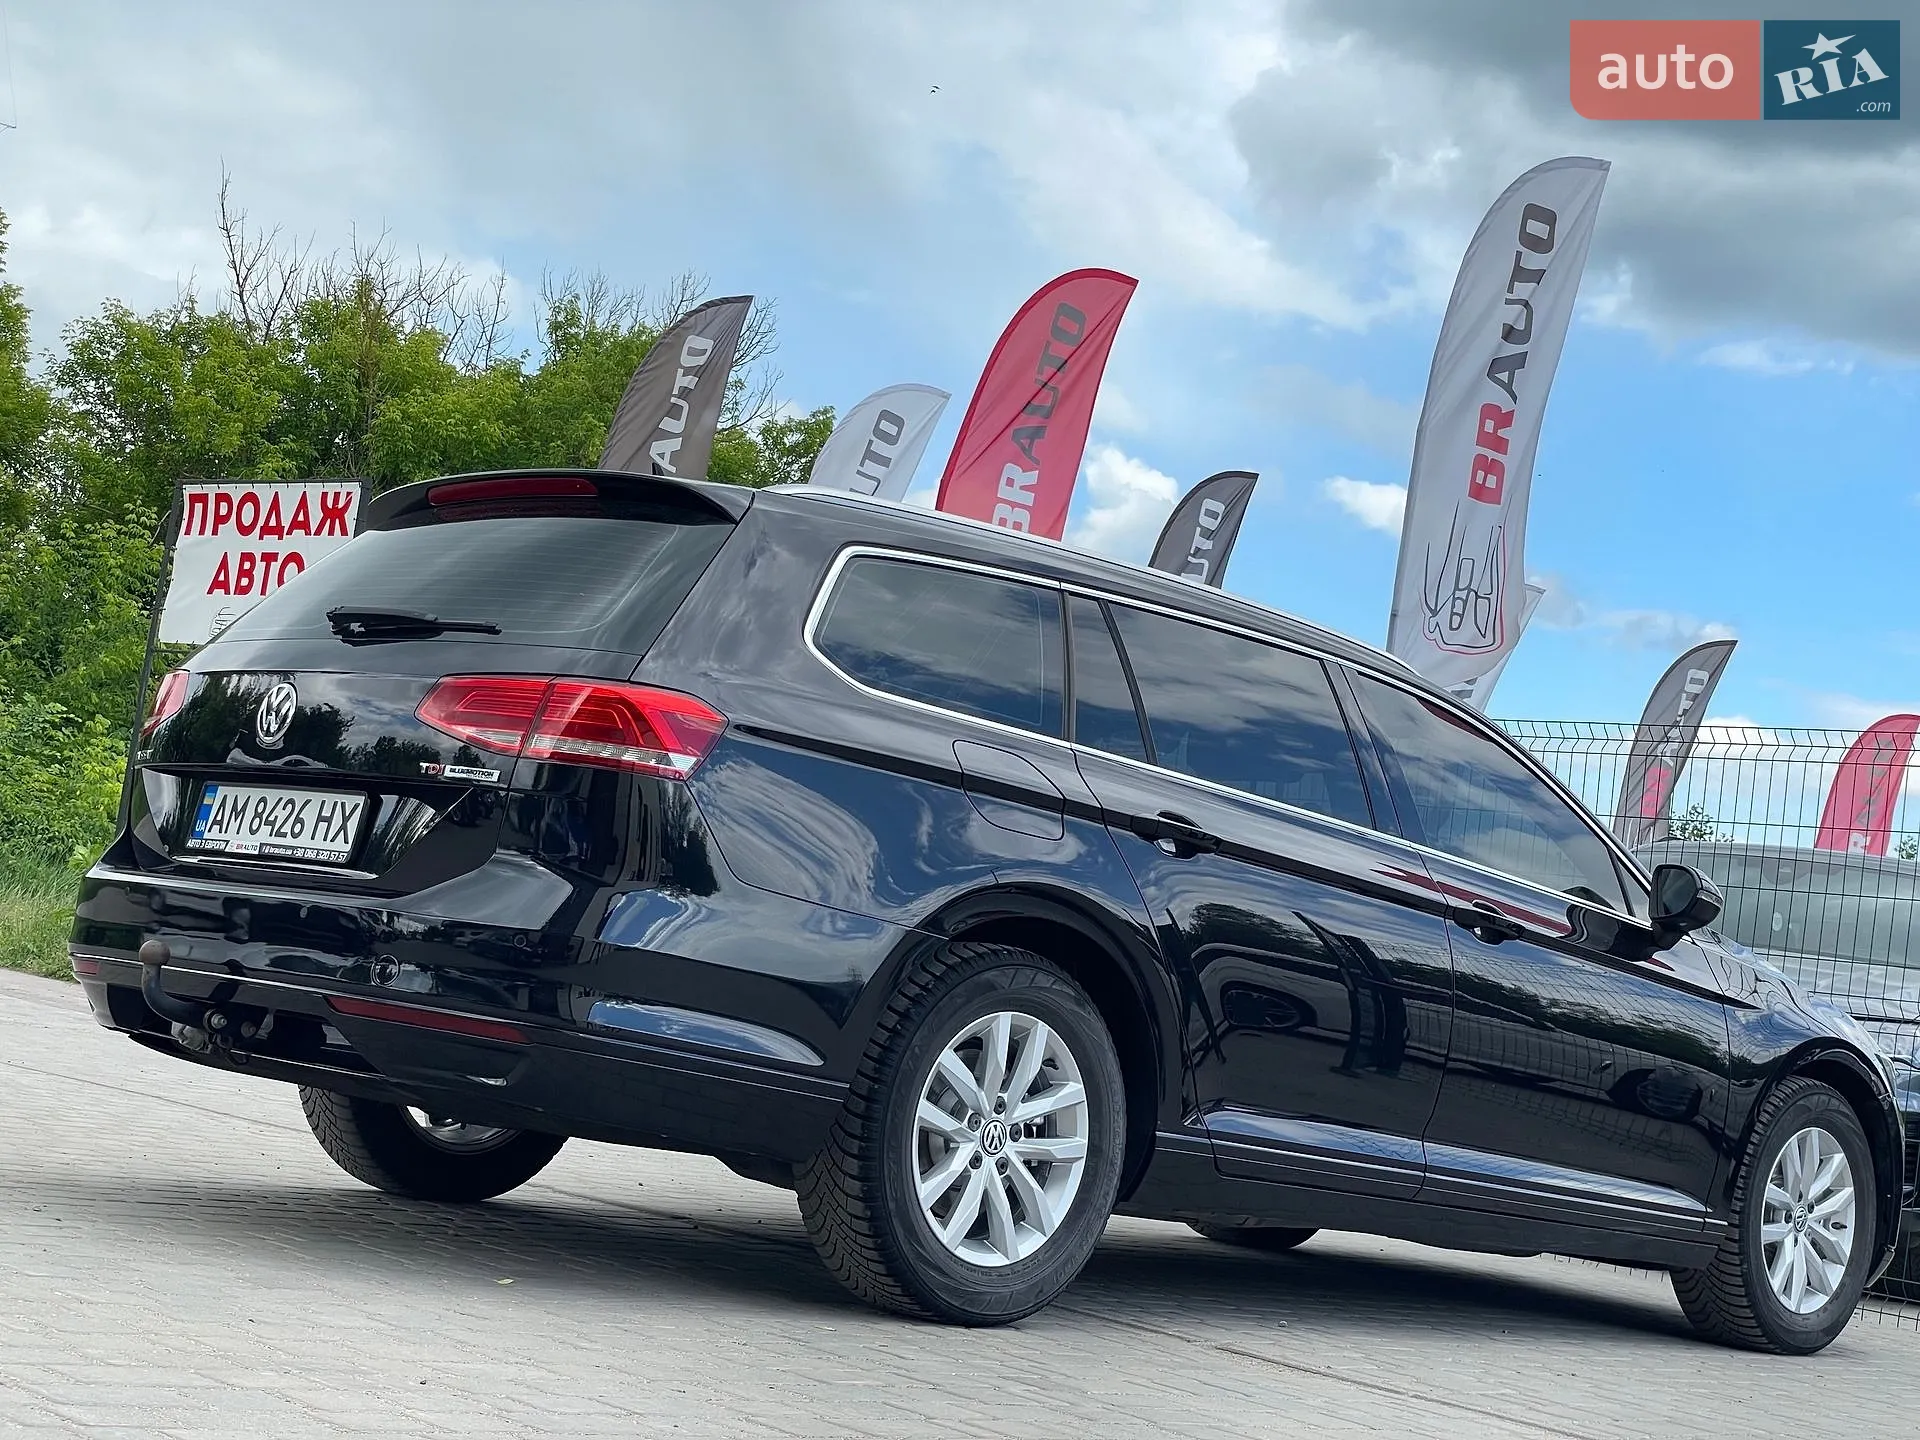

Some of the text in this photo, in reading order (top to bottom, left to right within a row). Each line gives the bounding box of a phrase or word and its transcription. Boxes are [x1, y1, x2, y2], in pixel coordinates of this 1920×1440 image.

[1467, 203, 1558, 506] BRAUTO
[184, 491, 353, 541] ПРОДАЖ
[420, 762, 445, 775] TDI
[207, 794, 360, 844] AM 8426 HX
